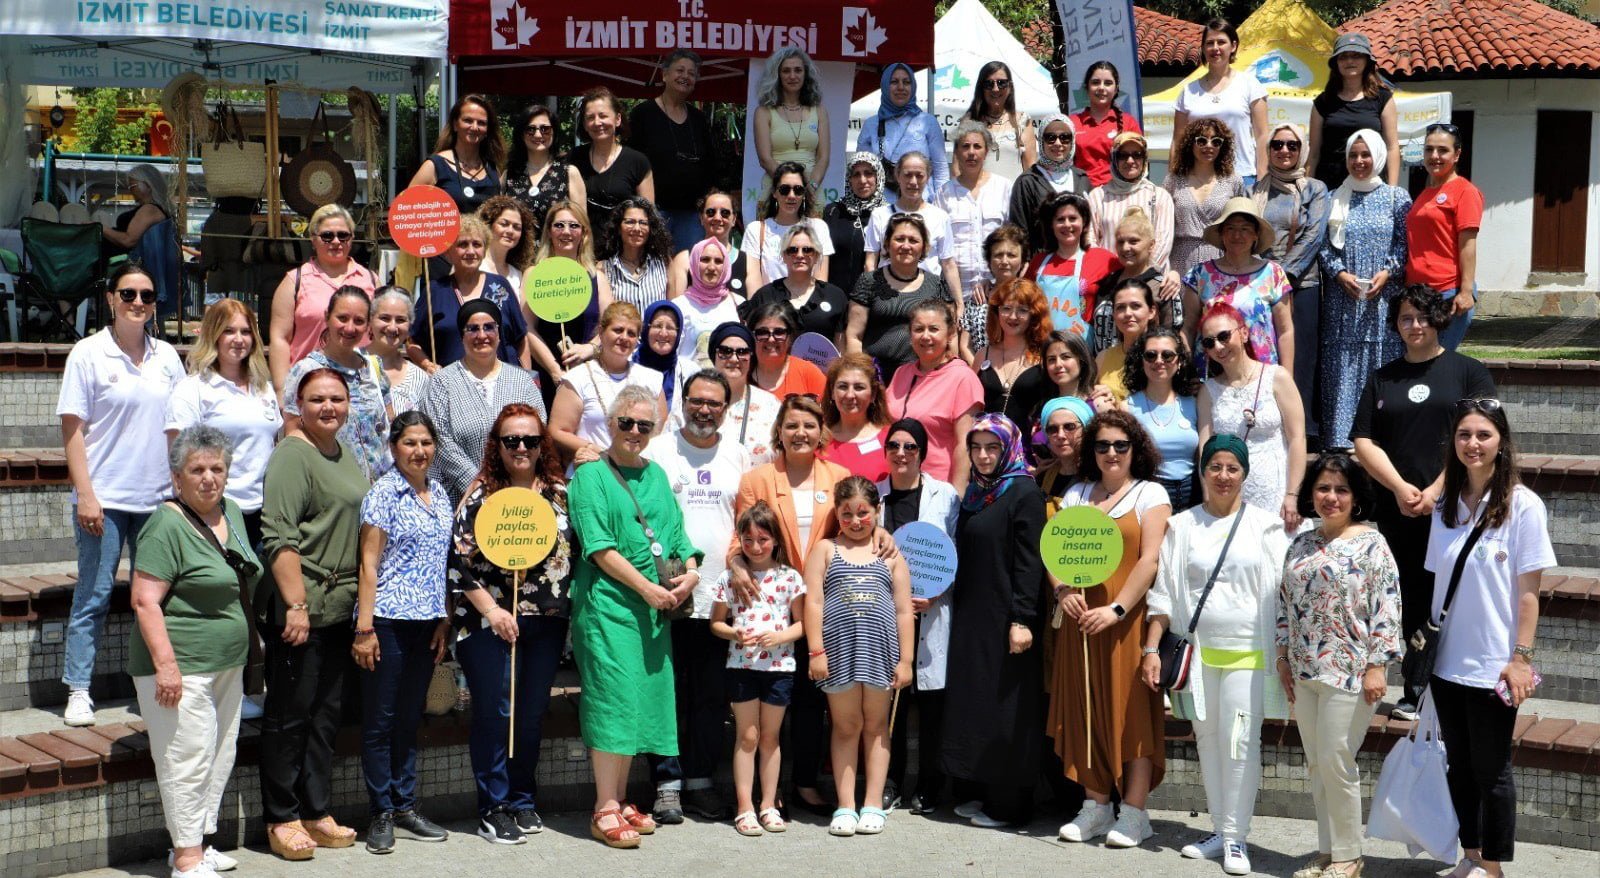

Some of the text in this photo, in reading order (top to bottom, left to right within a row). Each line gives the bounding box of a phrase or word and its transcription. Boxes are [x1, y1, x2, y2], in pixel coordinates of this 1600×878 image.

[325, 1, 437, 21] SANAT KENTİ
[678, 0, 708, 18] T.C.
[157, 2, 307, 36] BELEDİYESİ
[325, 21, 370, 40] İZMİT
[565, 16, 817, 54] İZMİT BELEDİYESİ
[397, 203, 411, 211] Ben
[413, 202, 441, 210] ekolojik
[416, 211, 441, 219] açıdan
[394, 223, 422, 231] olmaya
[423, 221, 446, 229] niyetli
[407, 231, 446, 239] üreticiyim!
[535, 275, 582, 287] Ben de bir
[533, 286, 587, 299] türeticiyim!
[501, 504, 534, 519] İyiliği
[495, 521, 538, 534] paylaş,
[1051, 526, 1114, 539] Doğaya ve
[487, 535, 548, 548] iyi olanı al
[1062, 540, 1103, 551] insana
[1058, 555, 1108, 565] dostum!
